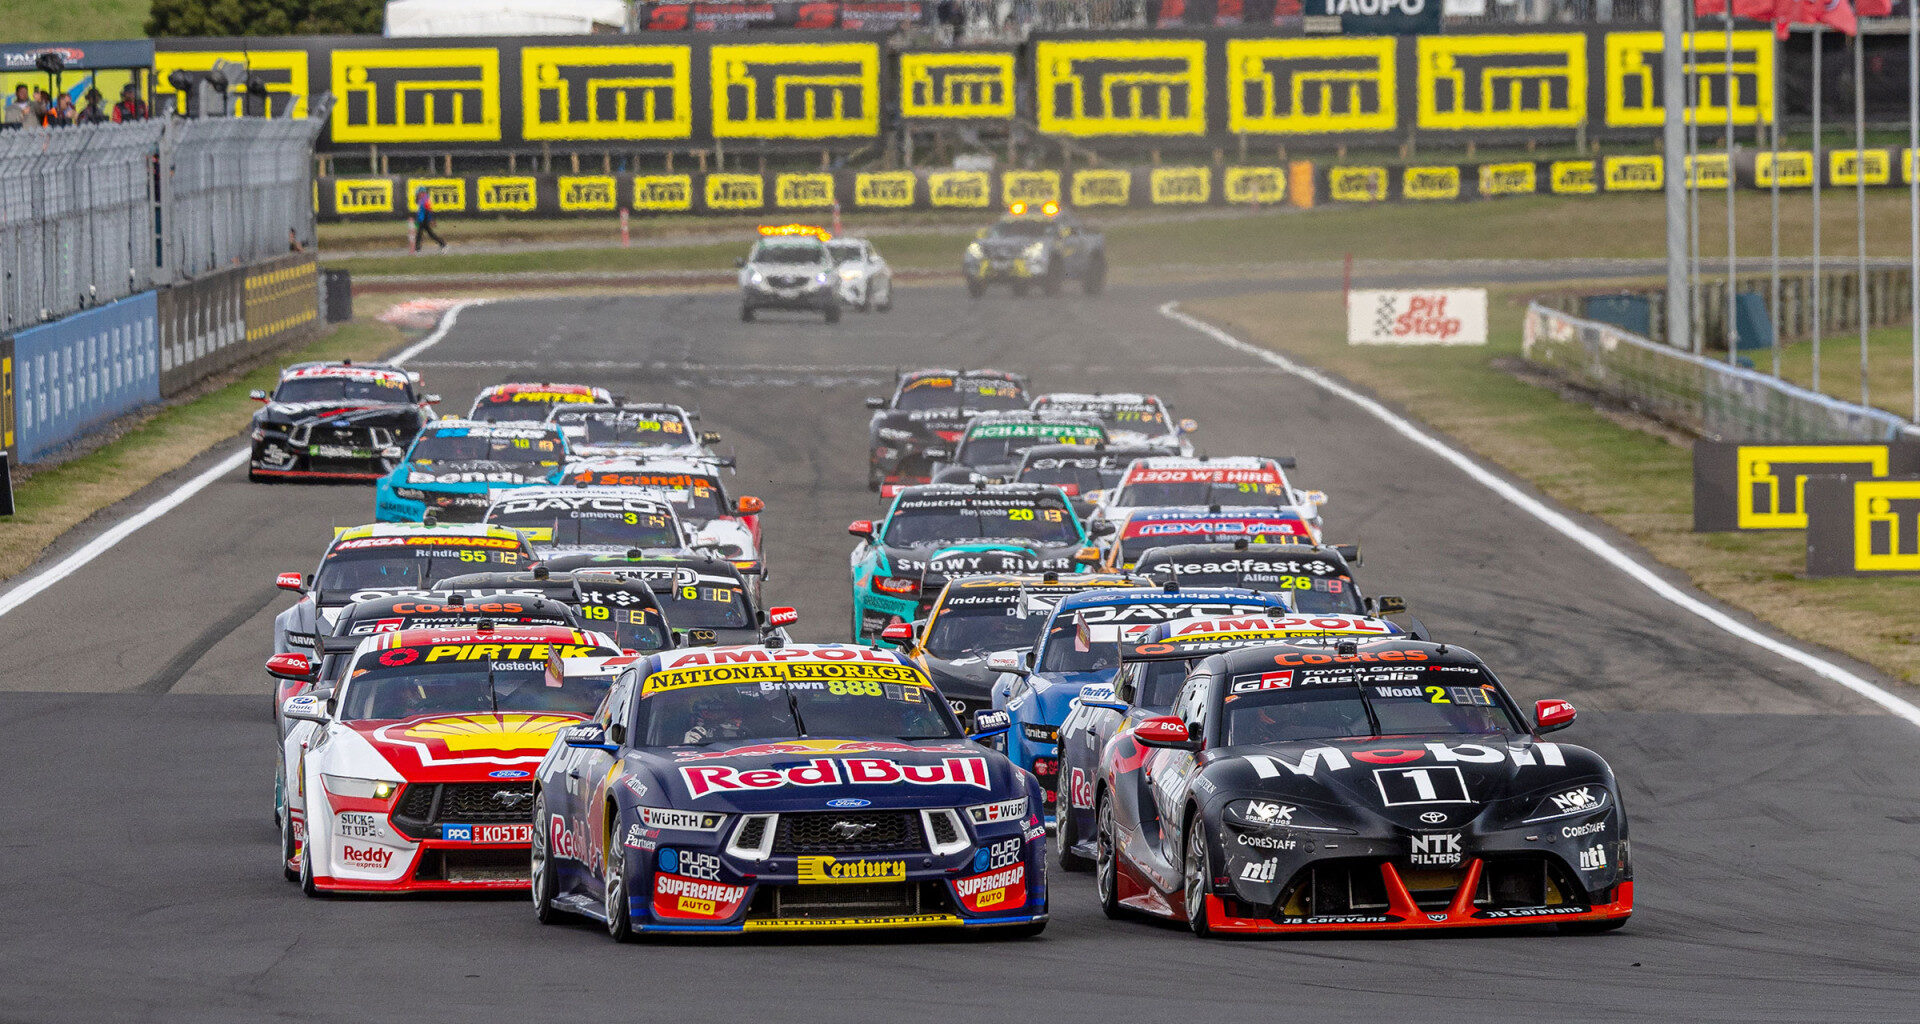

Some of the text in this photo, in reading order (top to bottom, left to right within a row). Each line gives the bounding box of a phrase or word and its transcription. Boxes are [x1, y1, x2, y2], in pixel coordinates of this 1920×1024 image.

[1407, 296, 1447, 318] Pit
[1394, 315, 1461, 338] Stop
[639, 420, 661, 432] 99
[1132, 471, 1187, 482] 1300
[1228, 471, 1275, 483] HIRE
[1238, 483, 1258, 494] 31
[503, 496, 658, 515] DAYCO
[901, 498, 1036, 509] Industrial Batteries
[571, 511, 624, 520] Cameron
[624, 512, 638, 525] 3
[1008, 508, 1034, 521] 20
[336, 536, 521, 550] MEGA REWARDS
[1254, 534, 1267, 545] 4
[460, 549, 487, 563] 55
[897, 556, 1070, 573] SNOWY RIVER
[277, 575, 301, 586] RYCO
[1244, 572, 1279, 583] Allen
[1280, 575, 1312, 590] 26
[682, 586, 697, 600] 6
[1130, 591, 1221, 600] Etheridge
[392, 602, 524, 614] Coates
[582, 605, 610, 620] 19
[1176, 616, 1385, 635] AMPOL
[432, 635, 547, 643] Shell V-Power
[1180, 635, 1408, 652] TRUCK ASSIST
[424, 643, 596, 663] PIRTEK
[668, 648, 895, 669] AMPOL
[1273, 648, 1429, 666] Coates
[287, 658, 307, 669] BOC
[491, 661, 544, 672] Kostecki
[1301, 667, 1367, 676] TOYOTA
[1428, 665, 1480, 674] Racing
[651, 663, 916, 690] NATIONAL STORAGE
[1233, 676, 1292, 693] GR
[1300, 672, 1419, 686] Australia
[760, 680, 825, 692] Brown
[827, 680, 883, 697] 888
[1376, 685, 1423, 699] Wood
[1424, 685, 1452, 705] 2
[978, 710, 1011, 725] Thrifty
[1160, 722, 1184, 734] BOC
[1242, 742, 1566, 780] Mobil
[683, 757, 991, 798] Red Bull
[1400, 768, 1439, 800] 1
[1550, 786, 1596, 809] NGK
[1246, 799, 1297, 820] NGK
[341, 813, 368, 826] SUCK
[342, 824, 352, 836] IT
[354, 825, 368, 837] UP
[447, 828, 471, 840] PPQ
[991, 837, 1021, 857] QUAD
[1411, 833, 1462, 853] NTK
[343, 845, 394, 869] Reddy
[680, 850, 720, 869] QUAD
[990, 849, 1020, 870] LOCK
[1410, 852, 1461, 866] FILTERS
[1579, 843, 1607, 868] nti
[355, 862, 382, 870] express
[680, 862, 721, 882] LOCK
[806, 856, 907, 882] Century
[1240, 856, 1279, 880] nti
[657, 875, 745, 904] SUPERCHEAP
[956, 865, 1025, 898] SUPERCHEAP
[681, 900, 711, 911] AUTO
[979, 891, 1003, 904] AUTO
[1305, 914, 1388, 924] Caravans
[1489, 904, 1584, 919] JB Caravans
